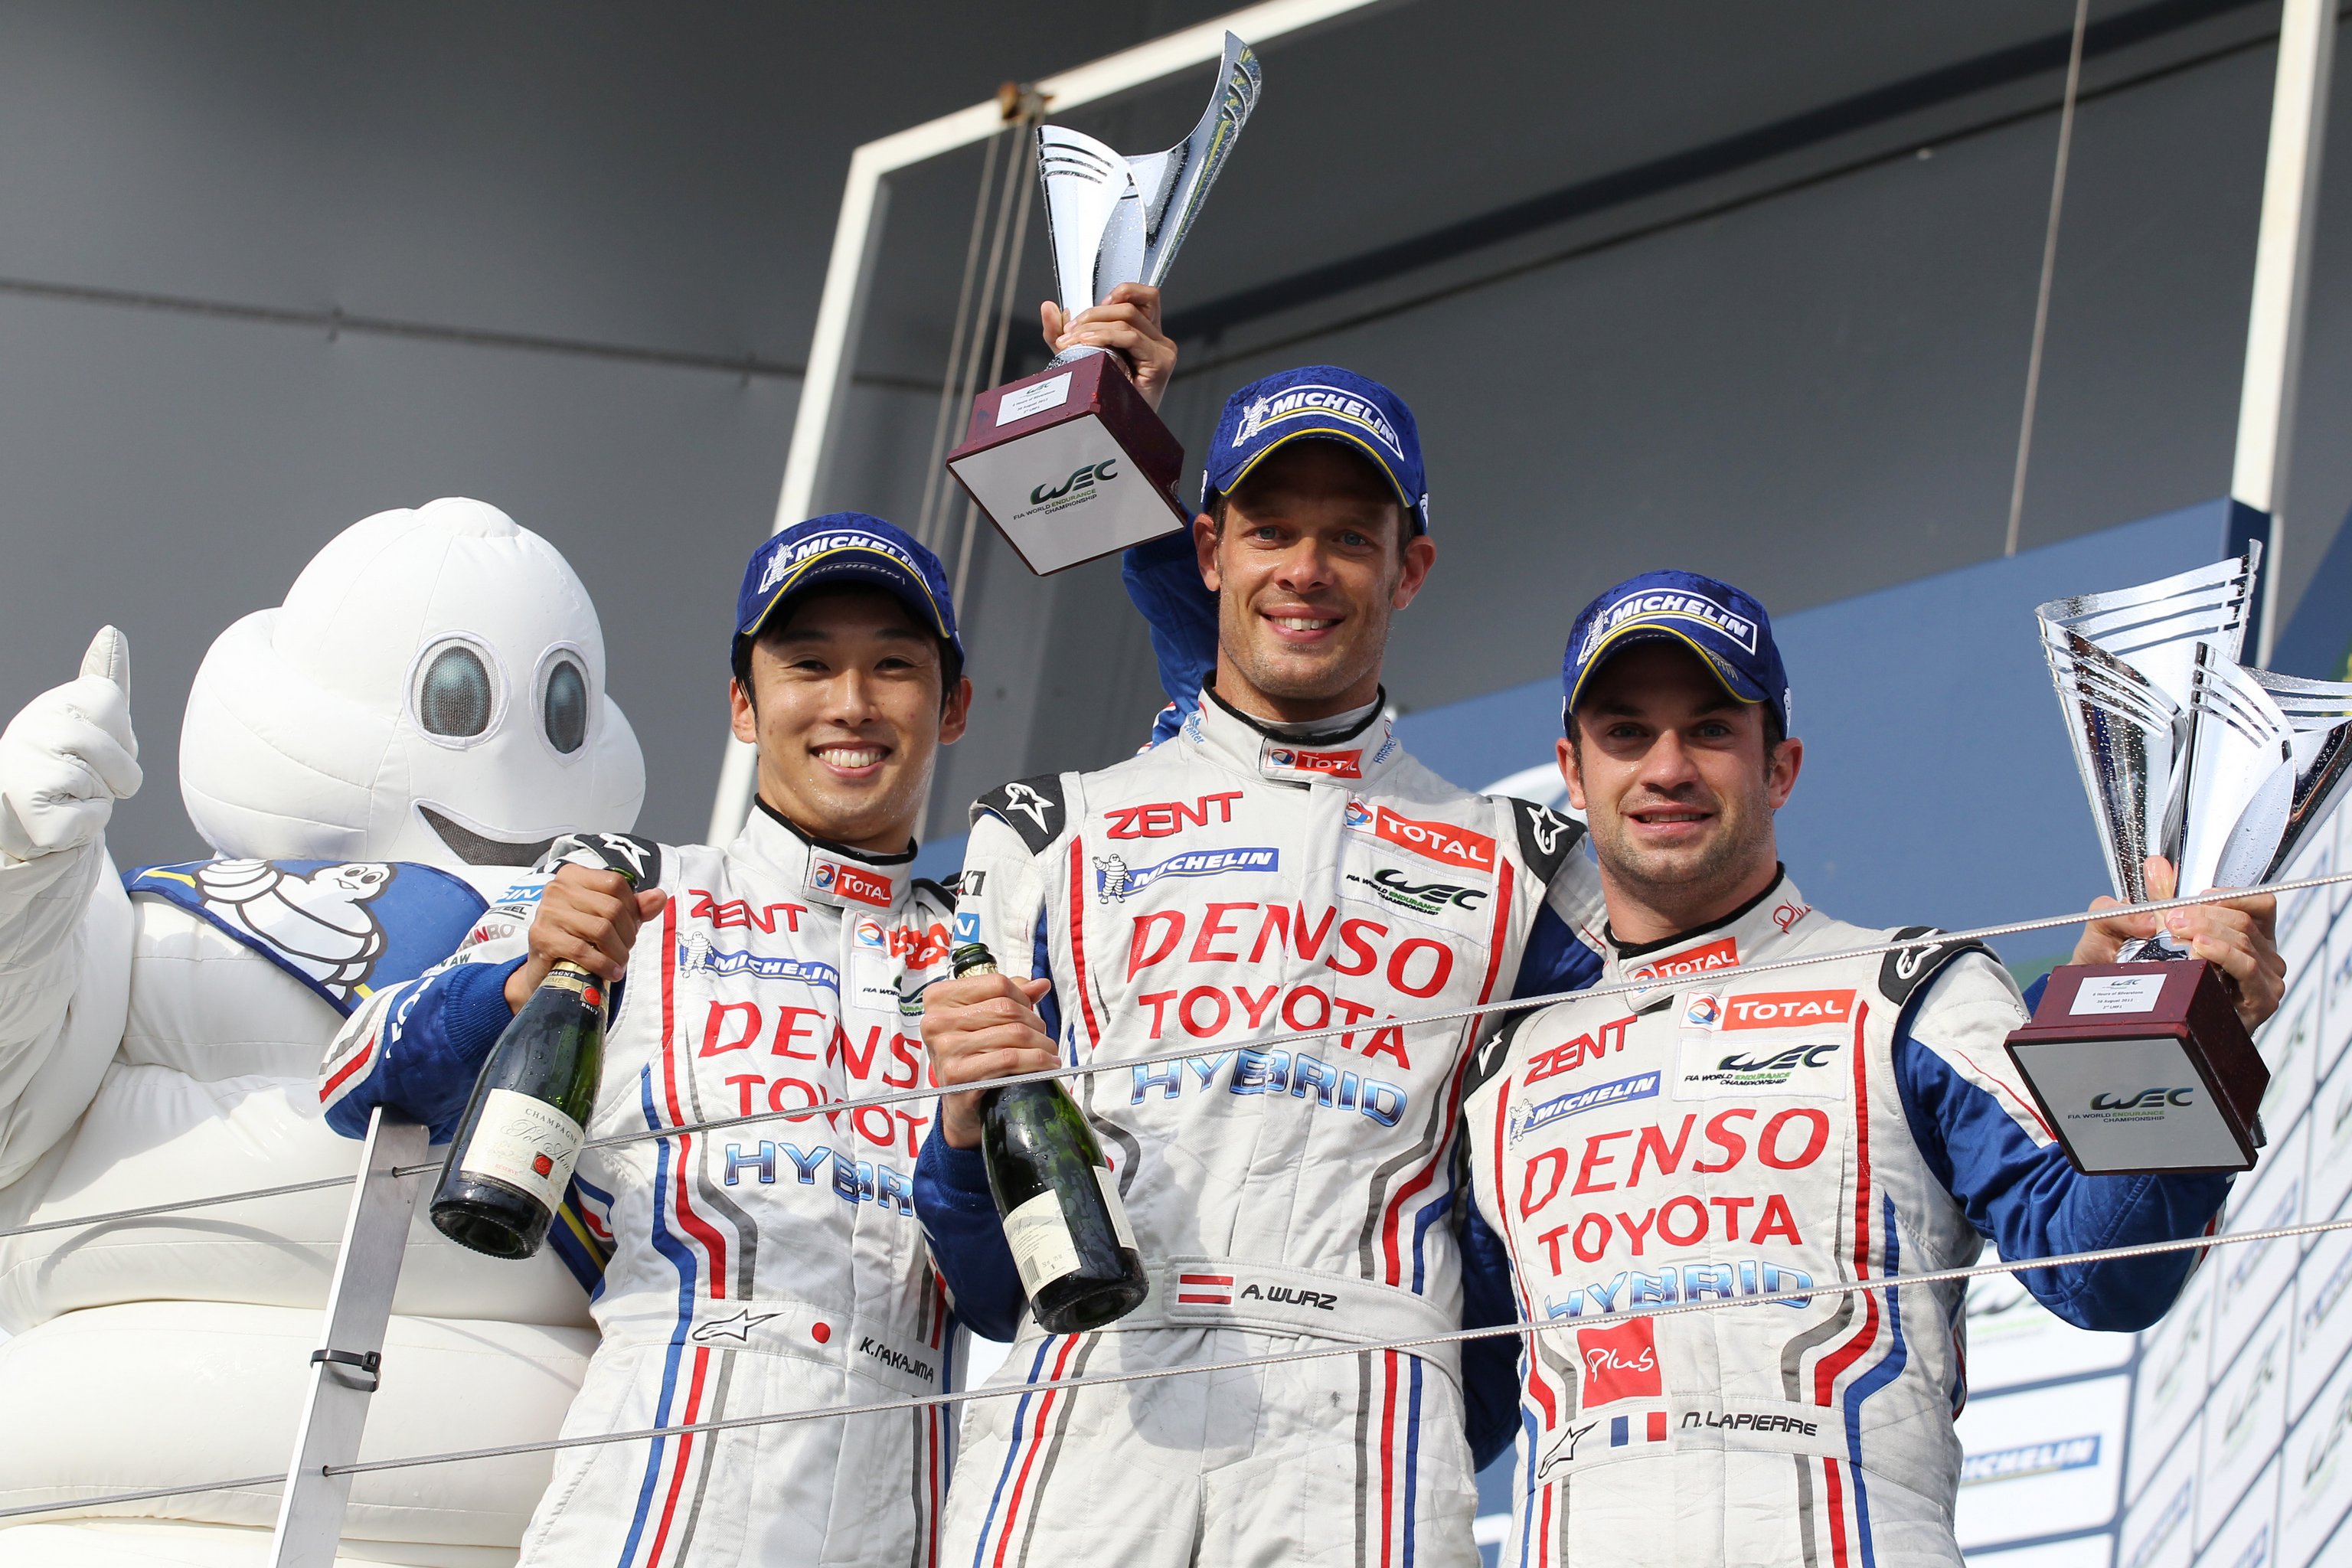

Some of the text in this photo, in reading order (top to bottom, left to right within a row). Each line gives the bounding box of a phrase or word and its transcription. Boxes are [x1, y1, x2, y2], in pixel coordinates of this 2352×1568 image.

[1269, 391, 1397, 444] MICHELIN
[1030, 458, 1119, 505] WEC
[1013, 488, 1097, 521] FIA WORLD ENDURANCE
[1044, 494, 1098, 515] CHAMPIONSHIP
[1609, 594, 1749, 639] MICHELIN
[1305, 753, 1357, 773] TOTAL
[1103, 791, 1244, 840] ZENT
[1382, 815, 1489, 864] TOTAL
[841, 871, 891, 902] TOTAL
[1132, 851, 1274, 889] MICHELIN
[1374, 869, 1488, 911] WEC
[688, 889, 808, 934] ZENT
[1363, 878, 1387, 894] WORLD
[1389, 890, 1443, 912] ENDURANCE
[1377, 892, 1439, 916] CHAMPIONSHIP
[712, 953, 839, 985] MICHELIN
[1126, 899, 1454, 999] DENSO
[1658, 950, 1736, 978] TOTAL
[581, 1001, 599, 1016] BRUT
[1138, 985, 1411, 1070] TOYOTA
[1731, 998, 1845, 1022] TOTAL
[697, 999, 939, 1089] DENS
[1523, 1015, 1638, 1088] ZENT
[1717, 1044, 1841, 1072] WEC
[1130, 1048, 1408, 1128] HYBRID
[1720, 1078, 1788, 1086] CHAMPIONSHIP
[1734, 1072, 1792, 1080] ENDURANCE
[1532, 1074, 1659, 1125] MICHELIN
[2089, 1087, 2194, 1111] WEC
[525, 1107, 579, 1146] CHAMPAGNE
[1520, 1108, 1831, 1223] DENSO
[1537, 1194, 1804, 1277] TOYOTA
[1544, 1259, 1814, 1321] HYBRID
[1964, 1435, 2097, 1480] ICHELIN
